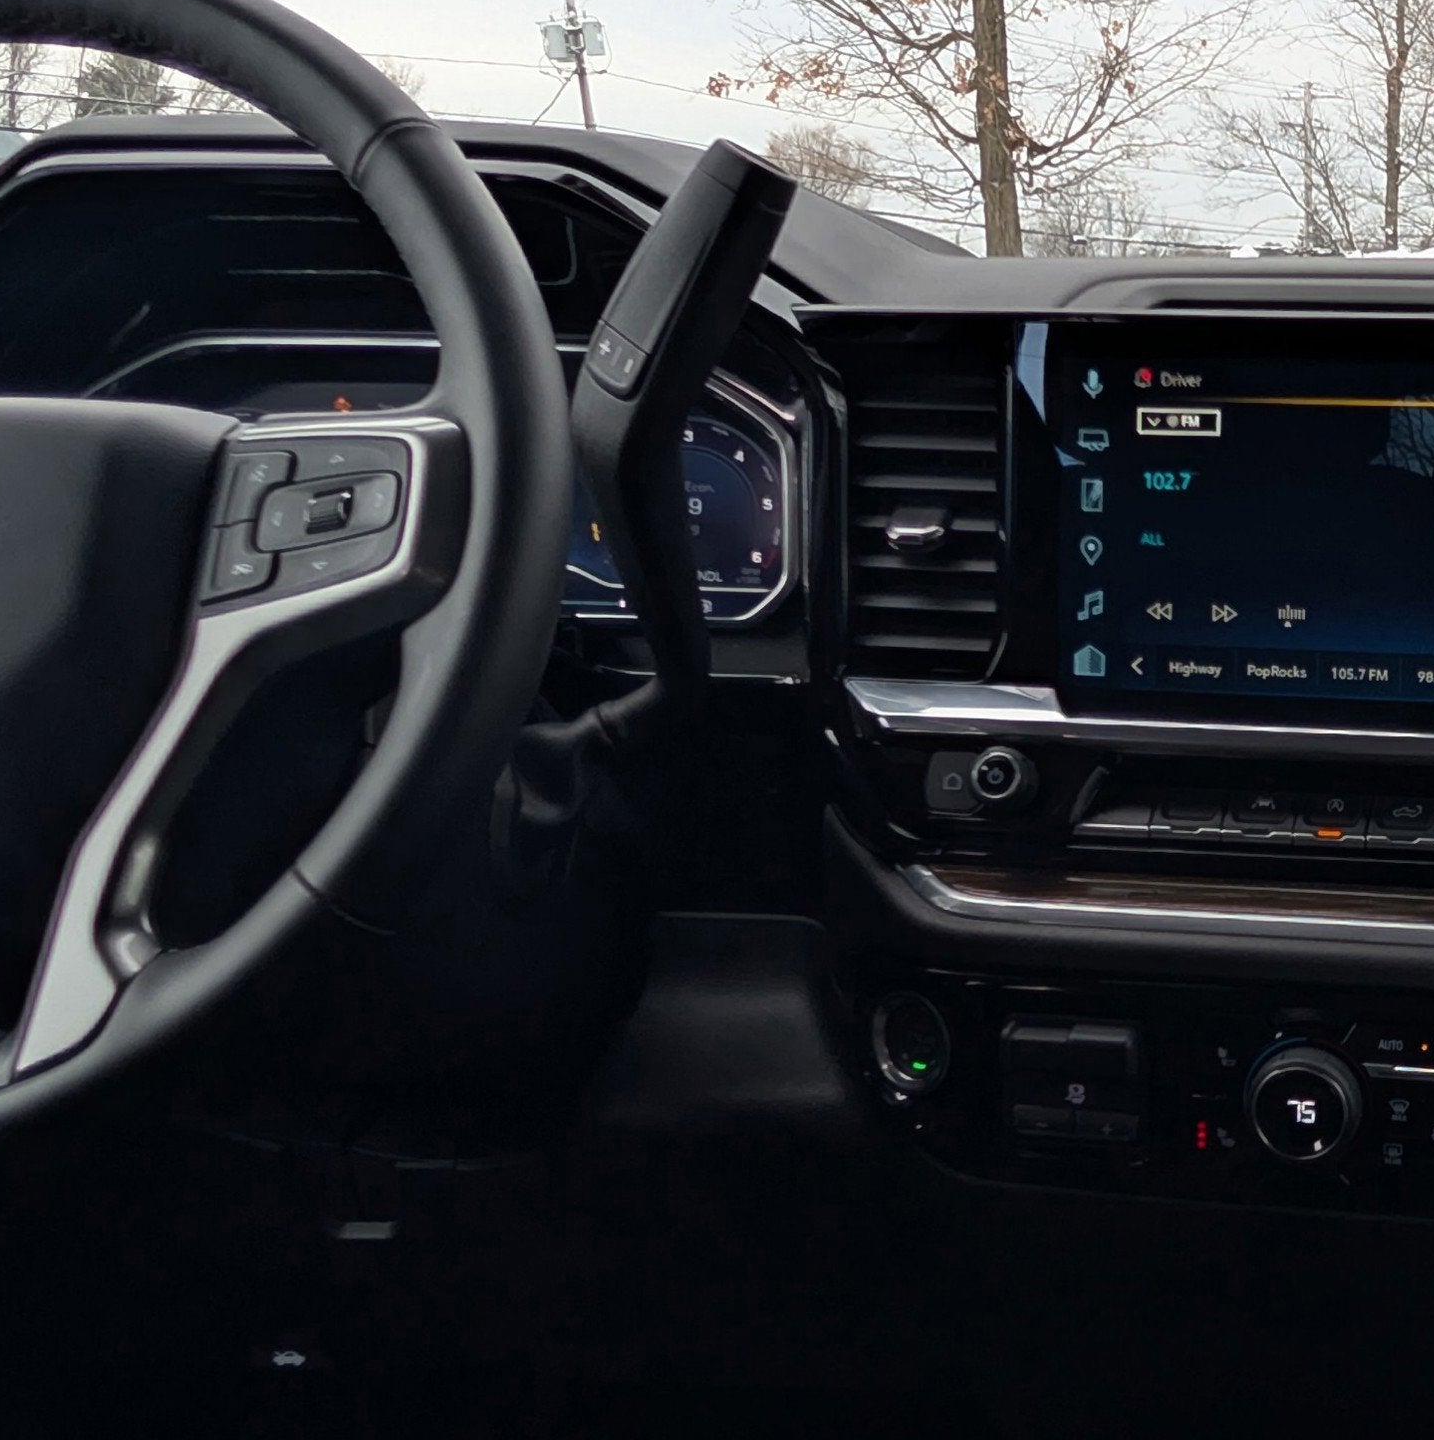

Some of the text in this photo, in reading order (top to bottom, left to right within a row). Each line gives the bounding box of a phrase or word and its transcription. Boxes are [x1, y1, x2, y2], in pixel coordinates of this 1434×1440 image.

[1159, 371, 1203, 388] Driver
[1180, 415, 1201, 428] FM
[682, 429, 695, 443] 3
[733, 450, 746, 463] 4
[1143, 471, 1192, 491] 102.7
[1139, 531, 1166, 547] ALL
[750, 550, 763, 564] 6
[1168, 661, 1223, 678] Highway
[1246, 664, 1308, 679] PopRocks
[1331, 667, 1389, 682] 105.7 FM
[1378, 1039, 1404, 1052] AUTO
[1286, 1098, 1317, 1124] 75
